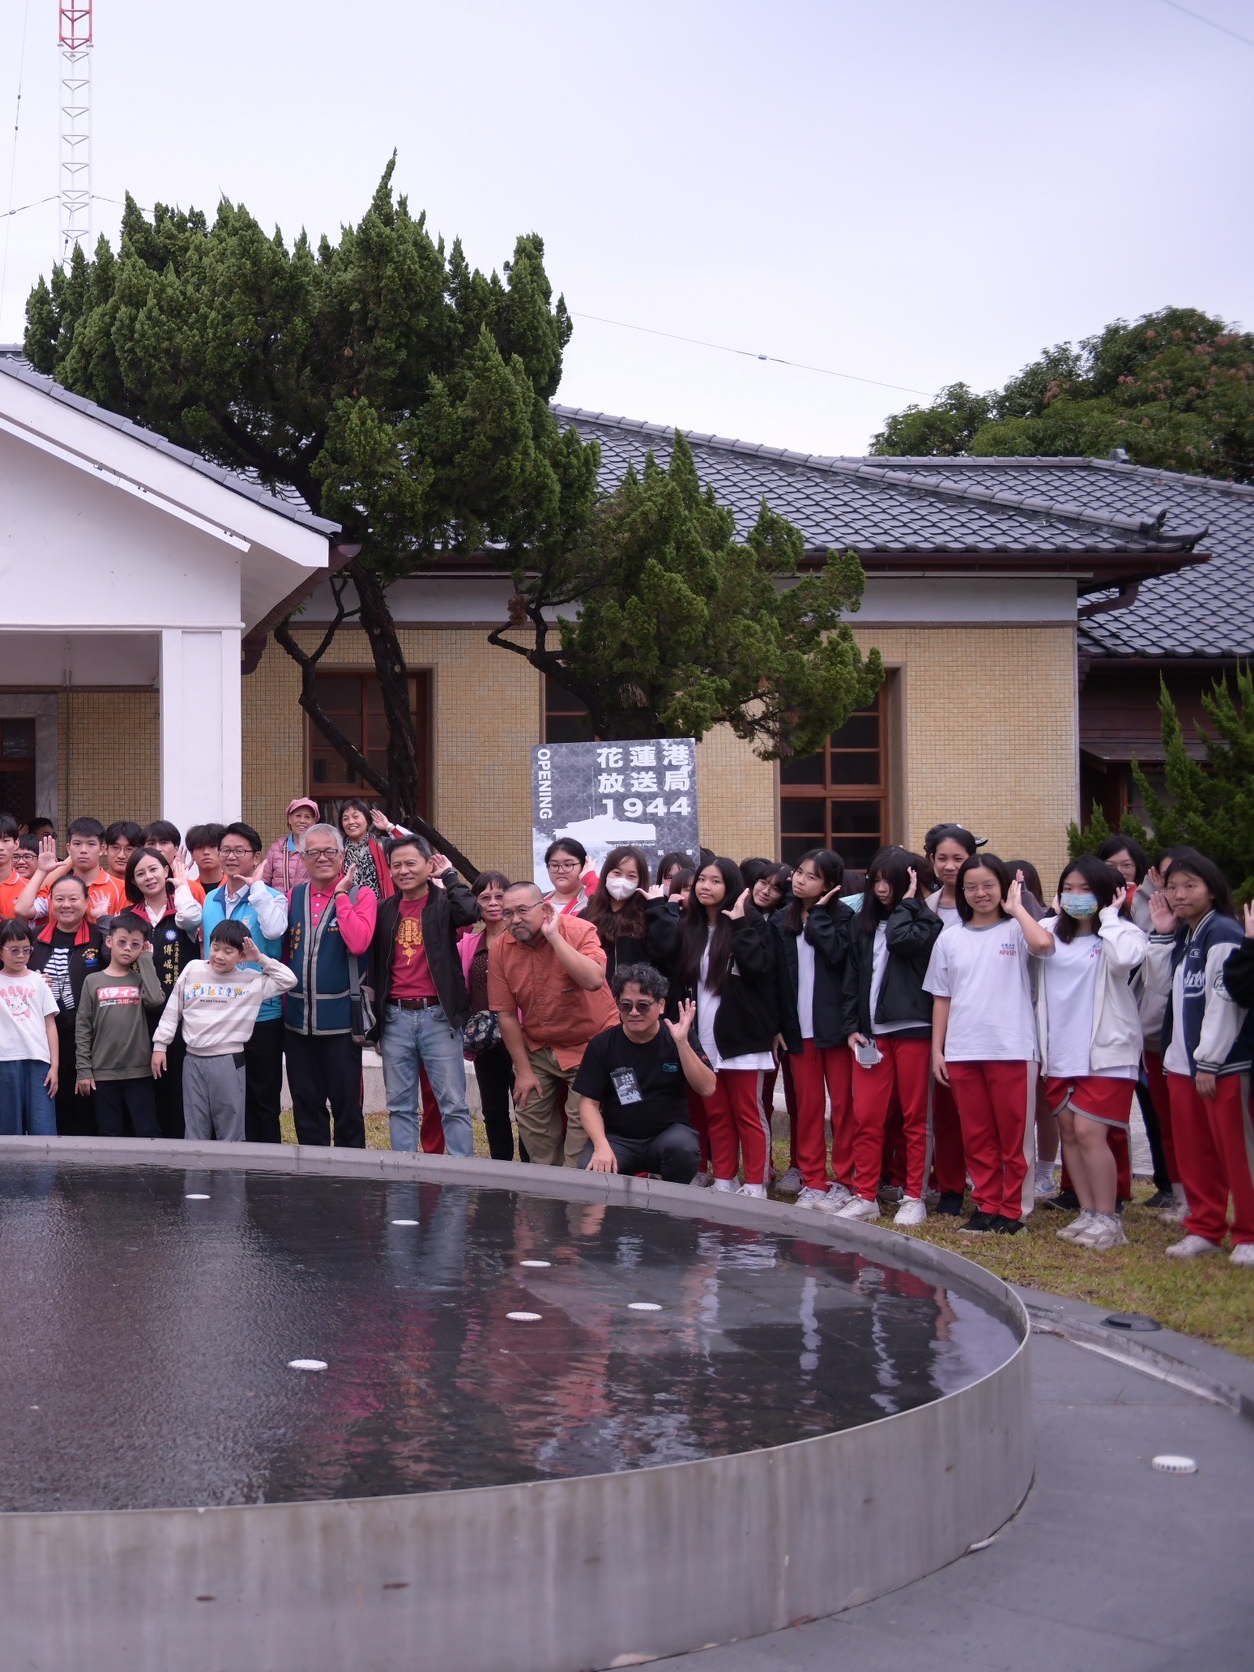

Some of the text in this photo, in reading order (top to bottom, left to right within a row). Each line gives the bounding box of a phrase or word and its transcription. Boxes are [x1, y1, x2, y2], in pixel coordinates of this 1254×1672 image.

[596, 745, 690, 769] 花蓮港
[537, 748, 553, 820] OPENING
[597, 770, 691, 794] 放送局
[602, 797, 691, 818] 1944
